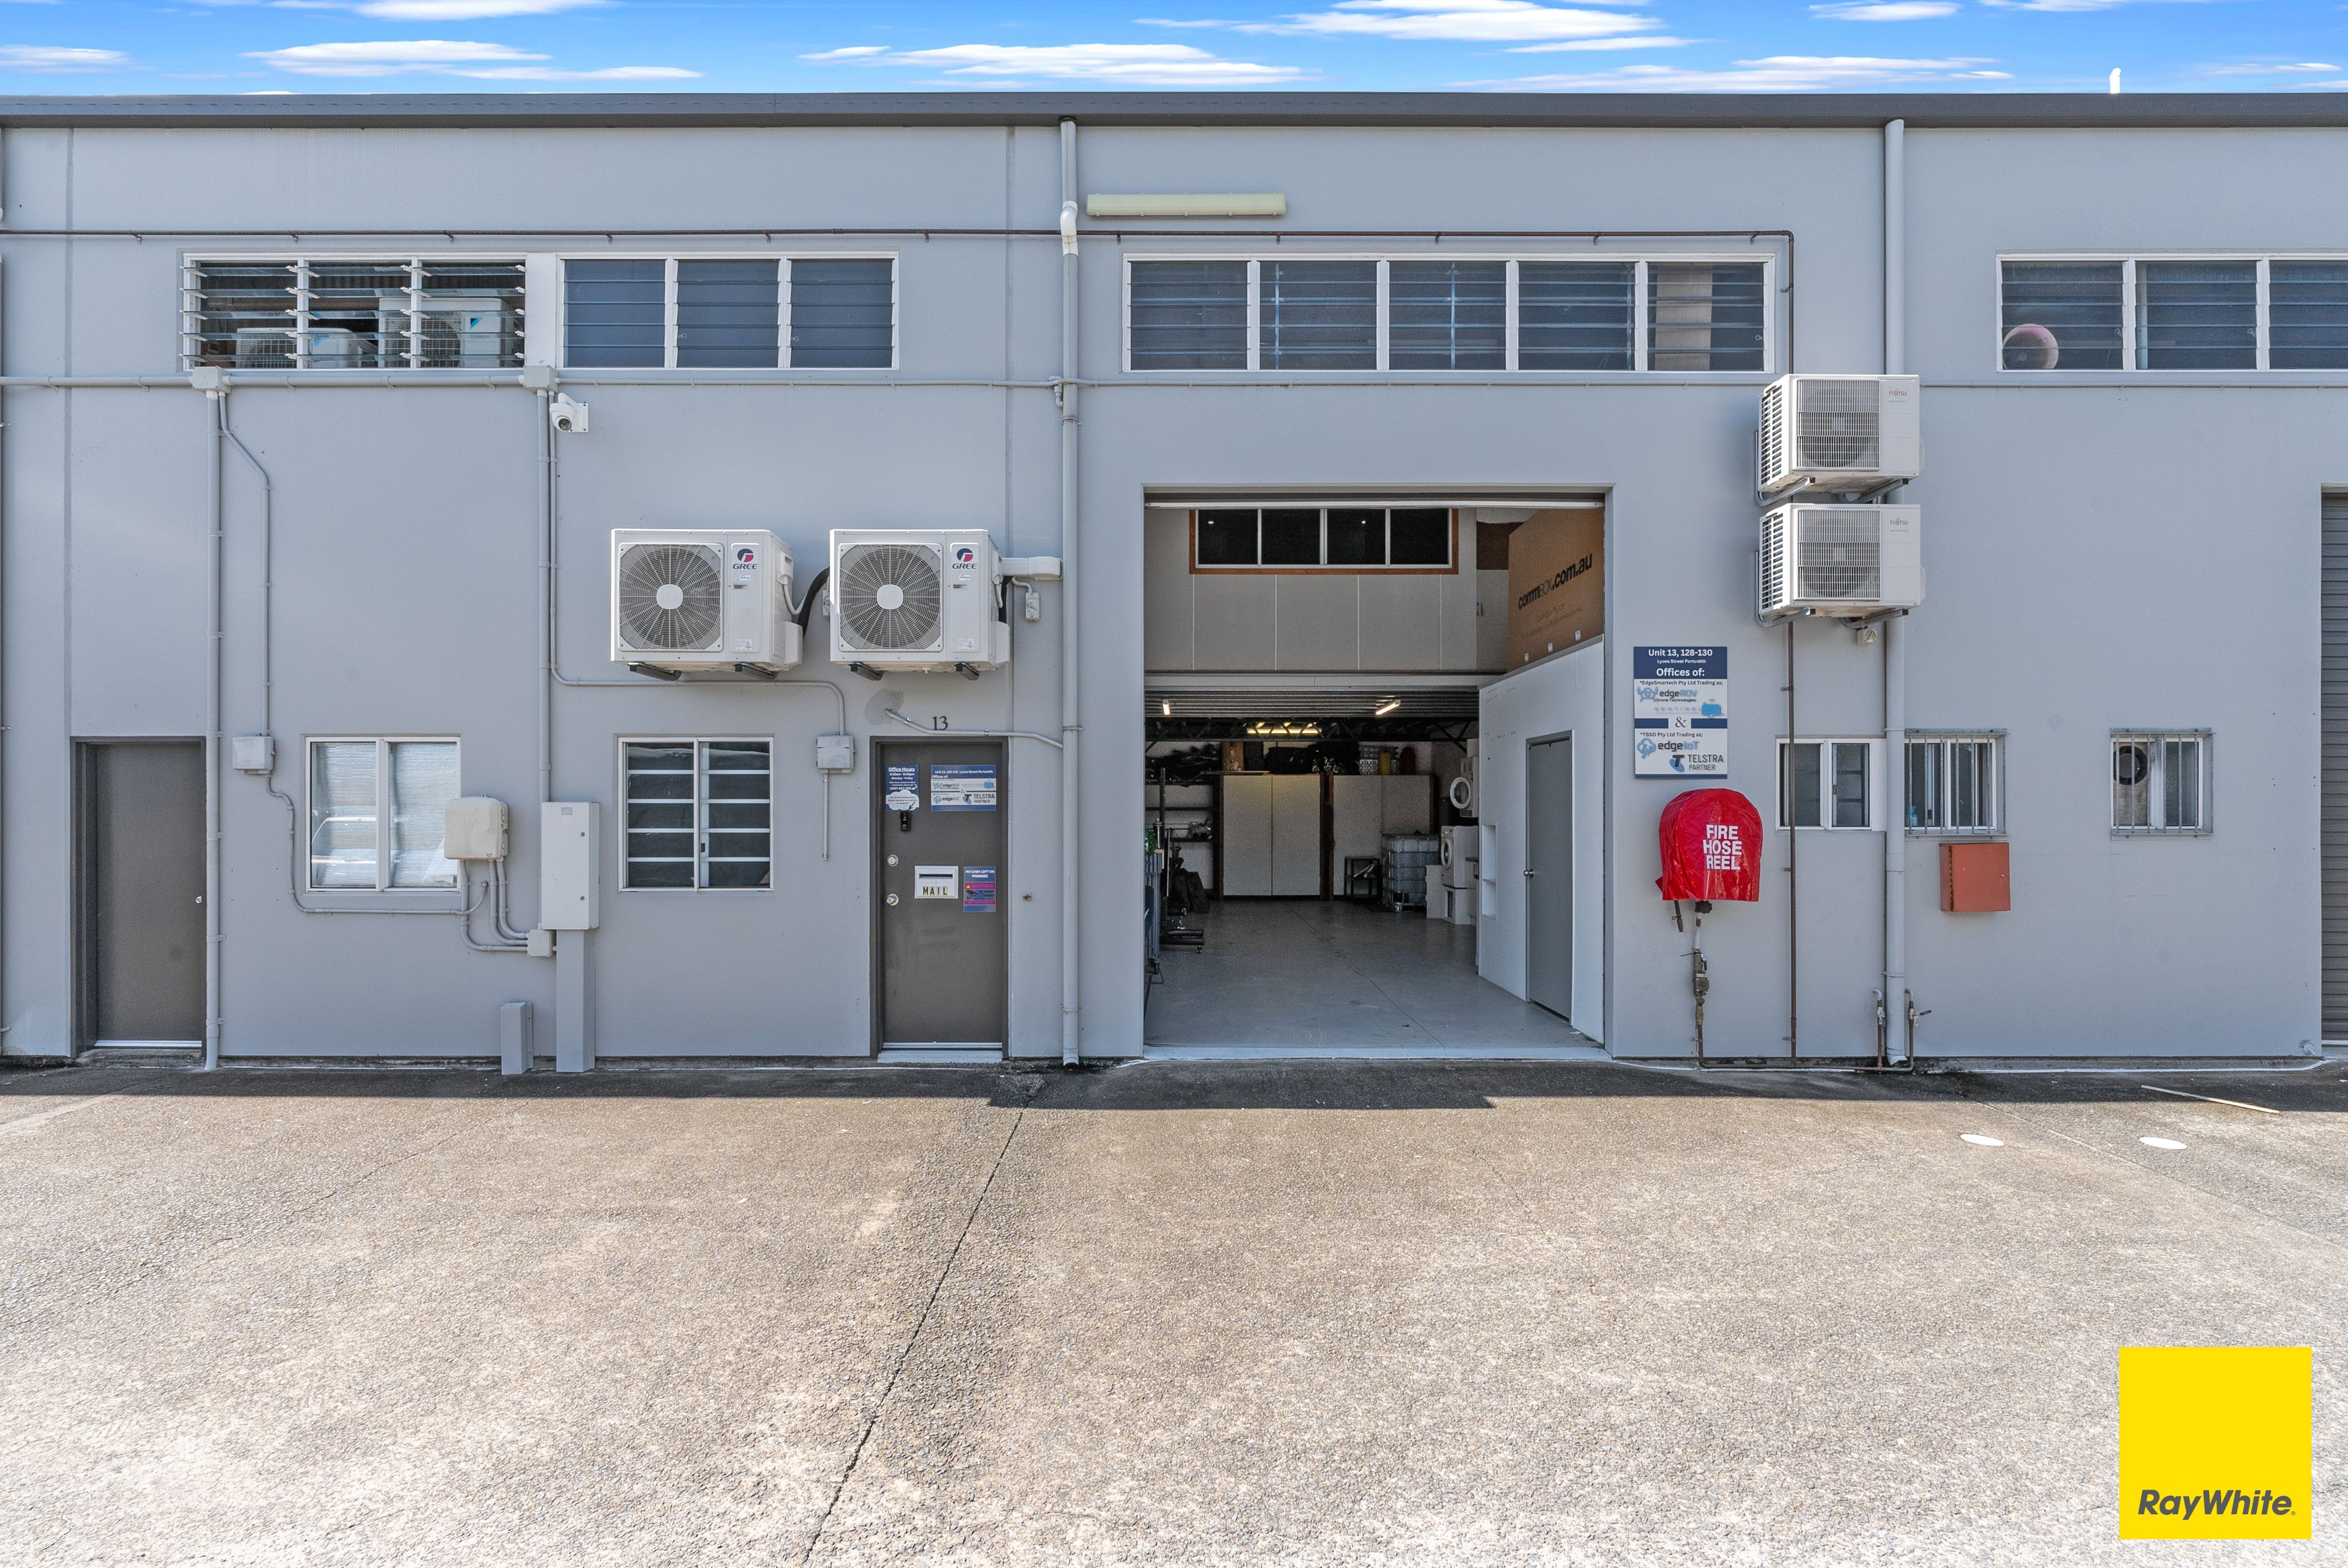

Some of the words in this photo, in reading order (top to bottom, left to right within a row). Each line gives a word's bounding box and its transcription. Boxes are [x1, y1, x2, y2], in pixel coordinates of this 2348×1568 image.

[1889, 388, 1907, 397] FUJITSU
[1890, 518, 1908, 526] FUJITSU
[1667, 649, 1679, 658] 13,
[932, 716, 948, 731] 13
[1675, 716, 1688, 728] &
[1688, 754, 1724, 763] TELSTRA
[1706, 824, 1738, 840] FIRE
[1702, 839, 1742, 855] HOSE
[1706, 855, 1741, 870] REEL
[923, 886, 947, 895] MAIL
